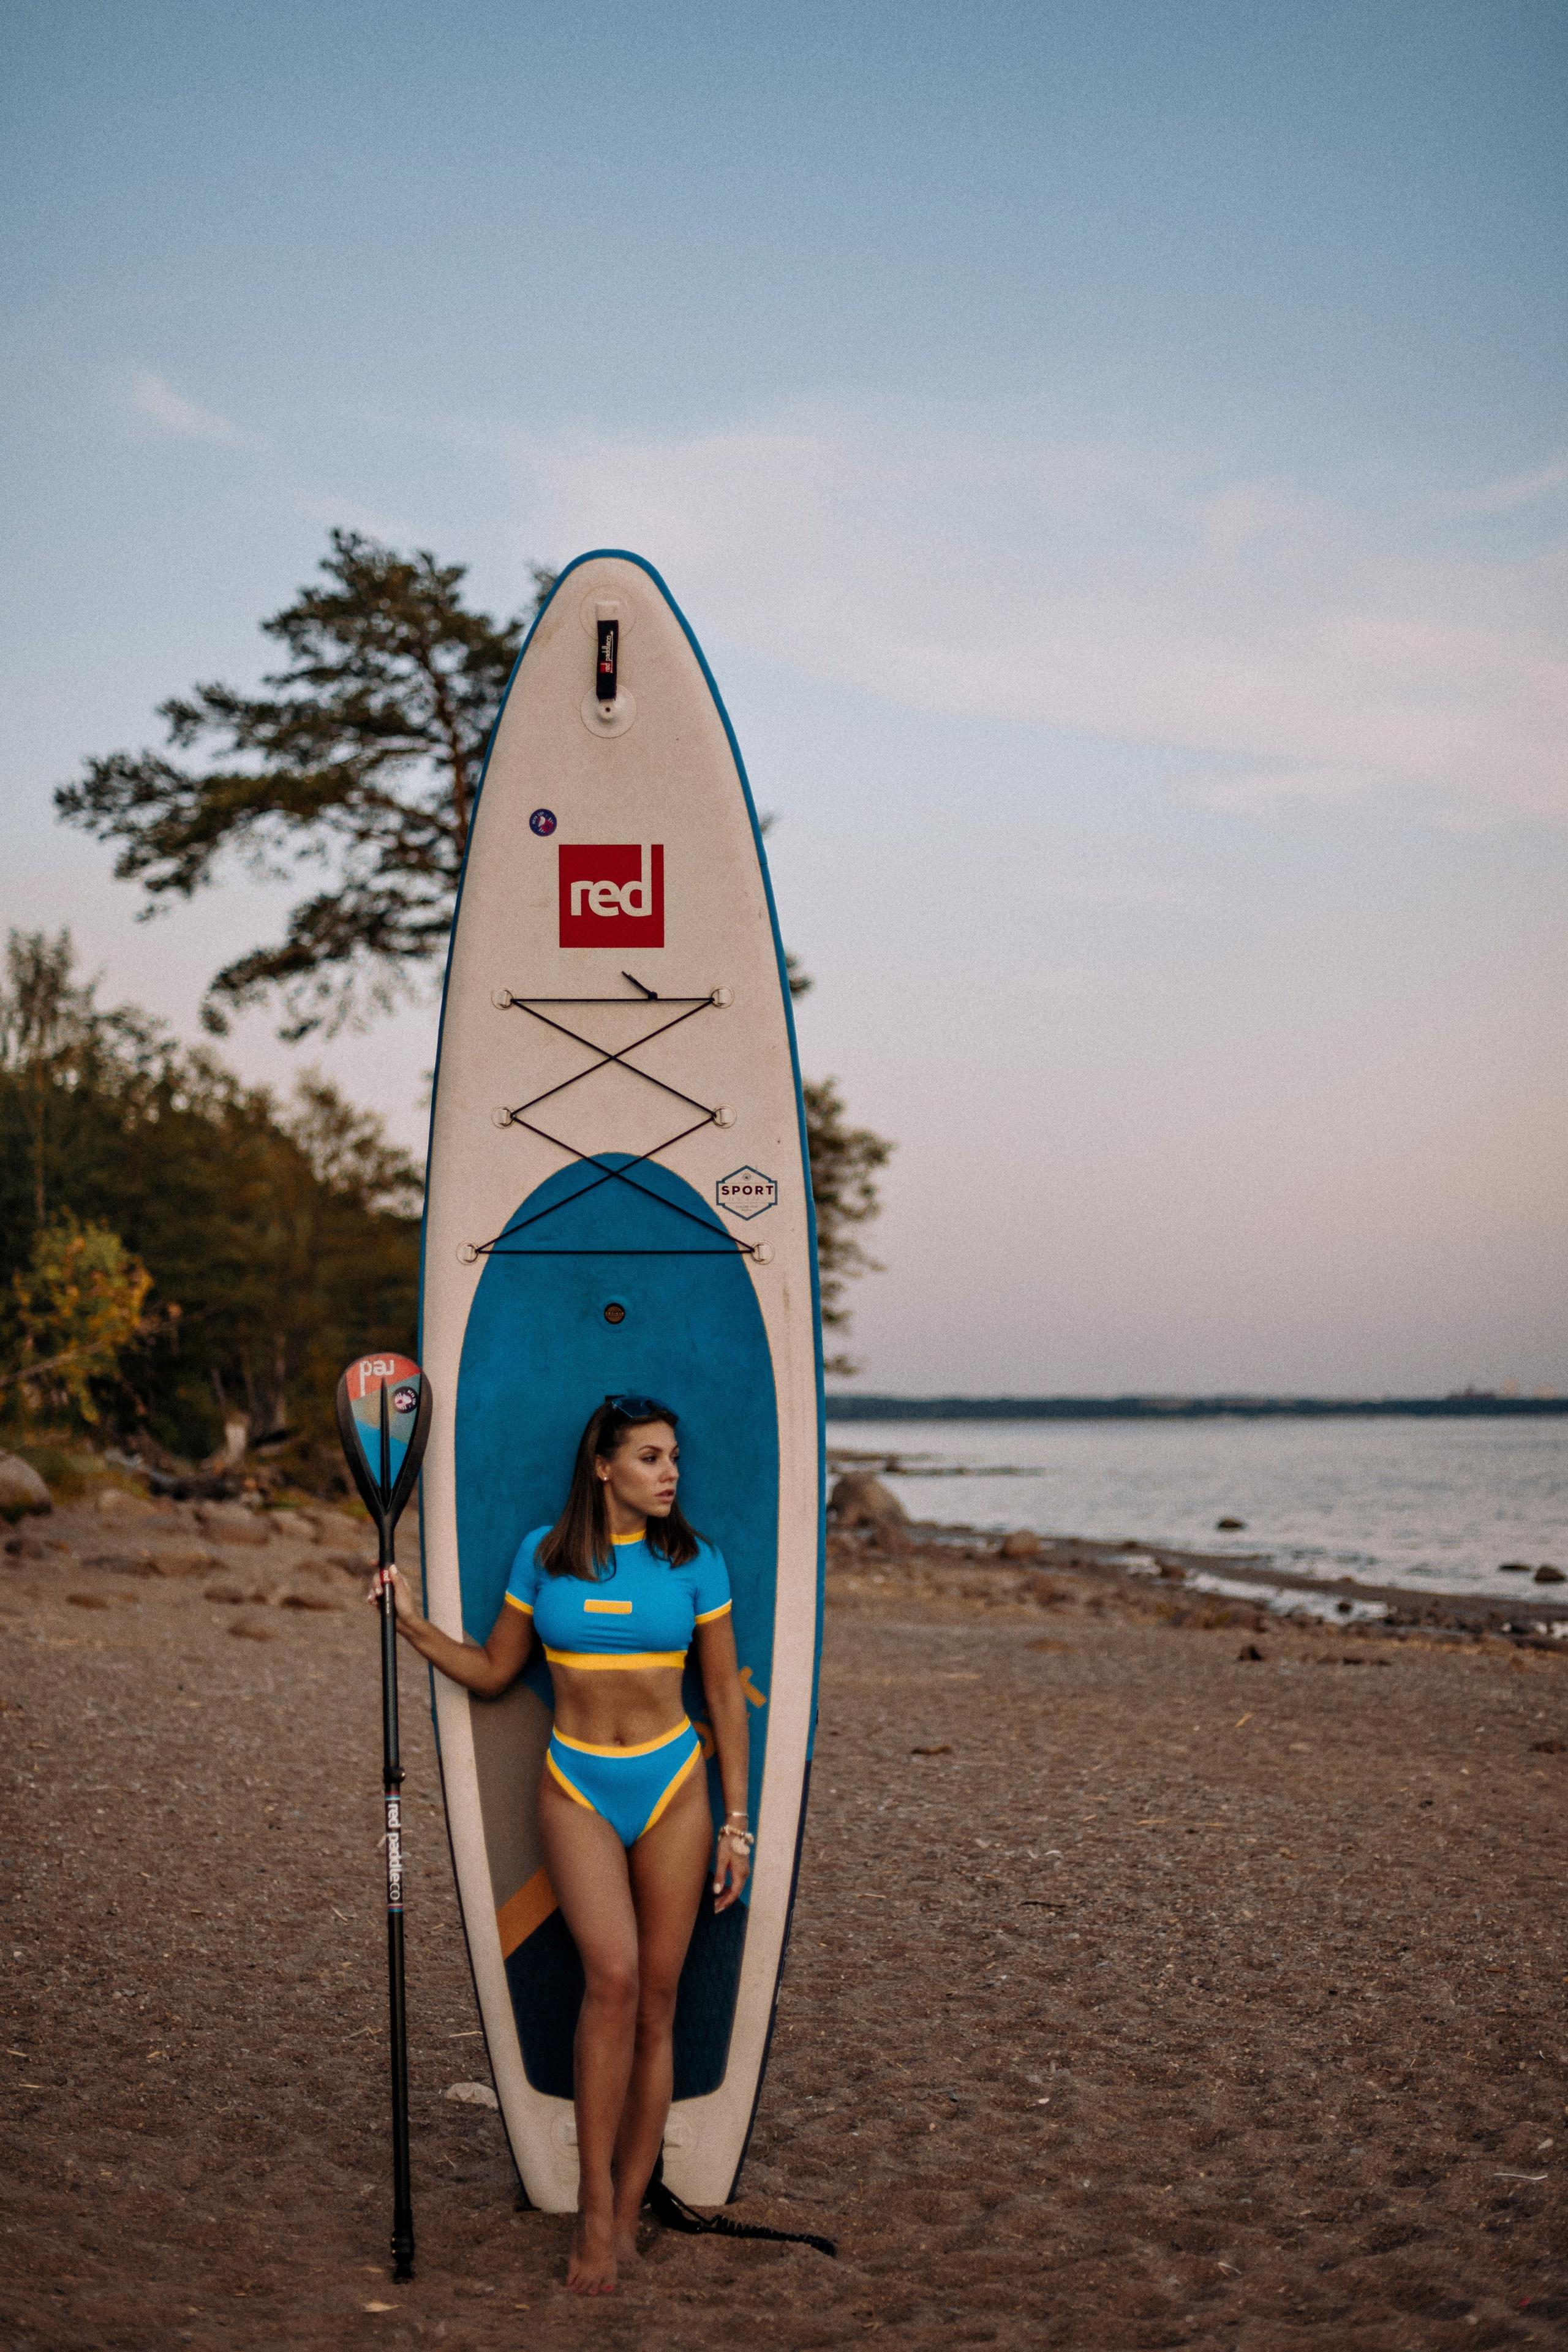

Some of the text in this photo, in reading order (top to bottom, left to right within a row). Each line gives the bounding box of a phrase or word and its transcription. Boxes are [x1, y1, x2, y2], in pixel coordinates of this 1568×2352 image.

[601, 663, 611, 673] red
[571, 845, 652, 917] red
[722, 1185, 774, 1195] SPORT
[360, 1360, 394, 1397] red
[388, 1803, 401, 1828] red
